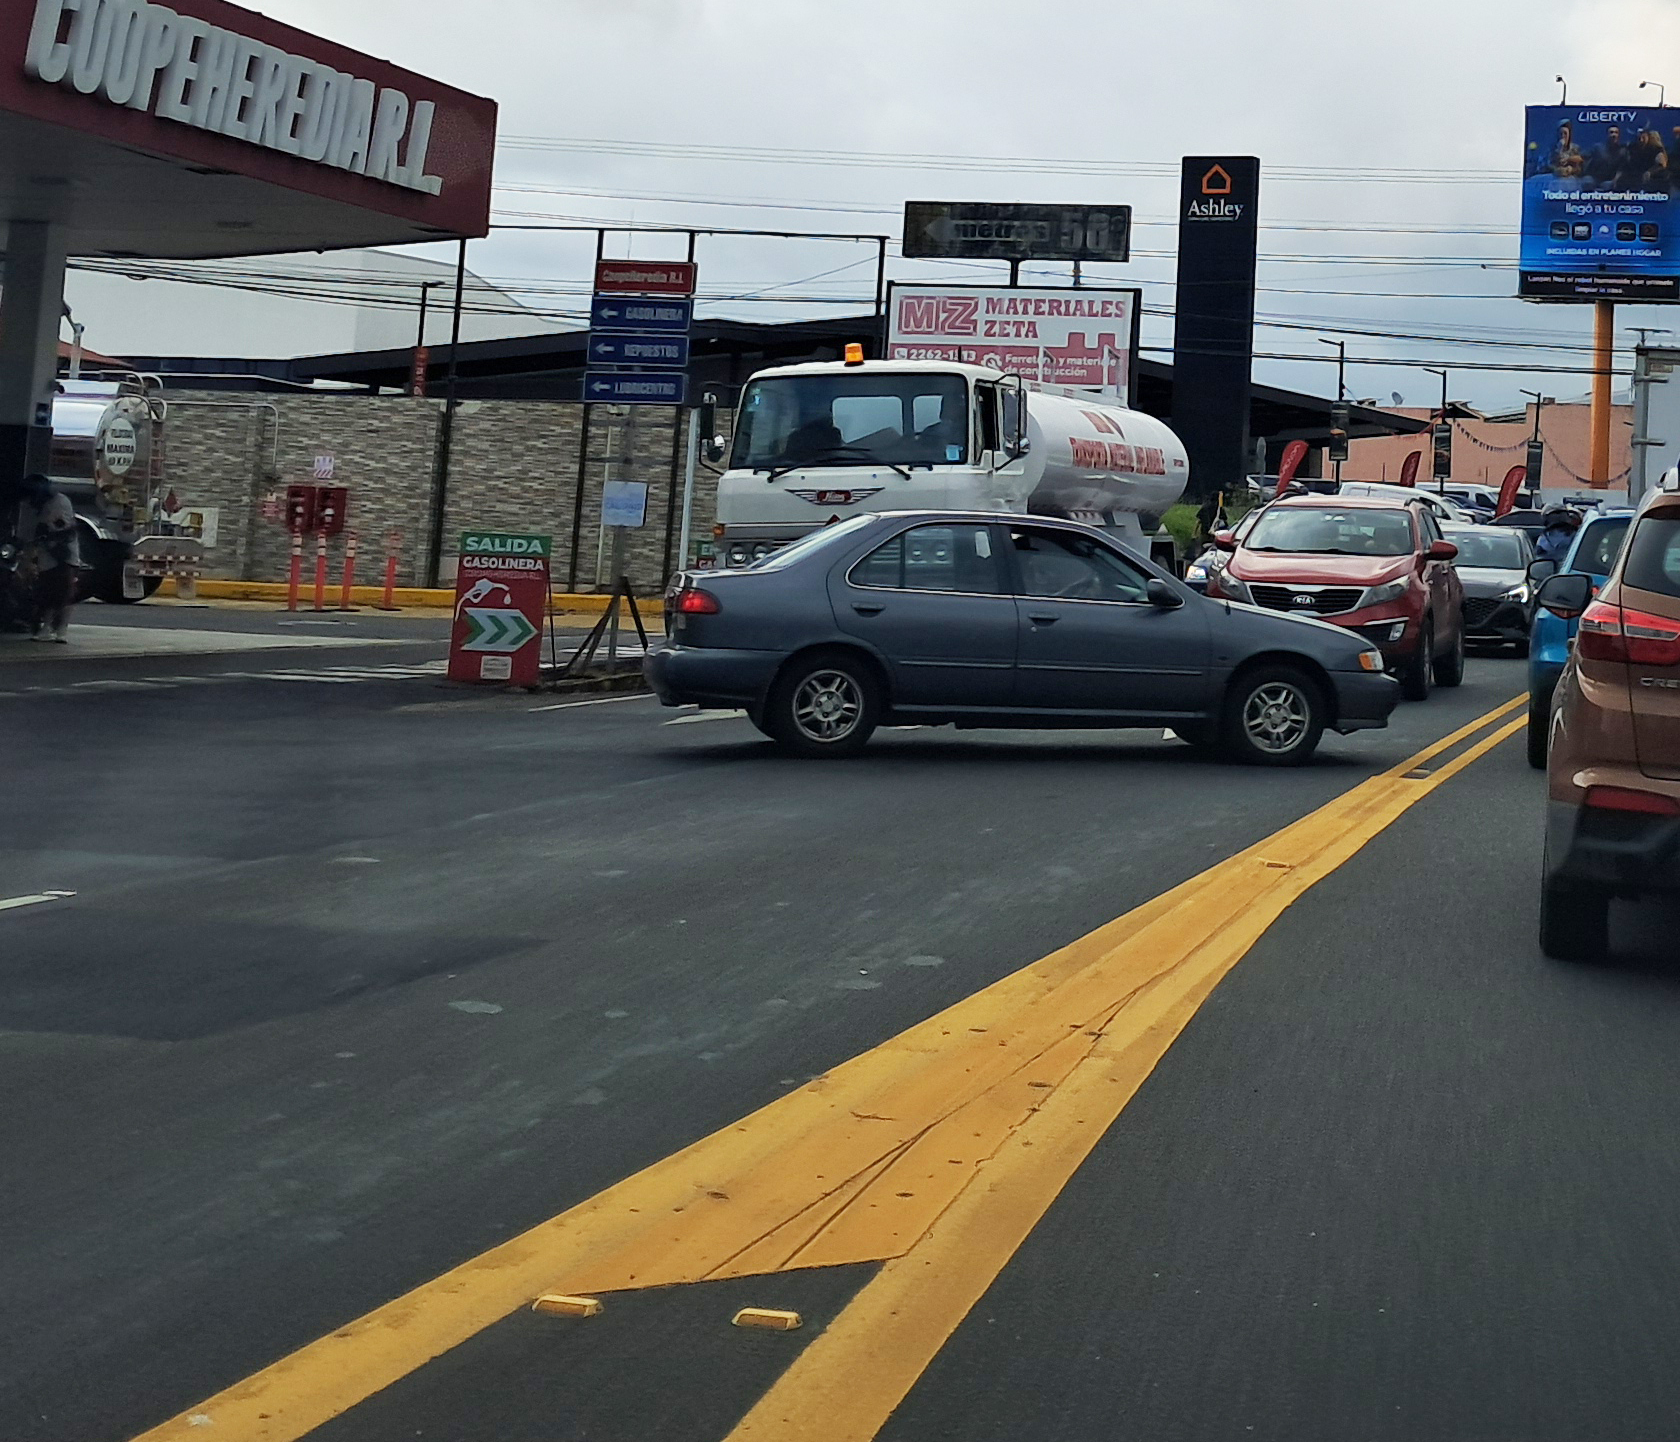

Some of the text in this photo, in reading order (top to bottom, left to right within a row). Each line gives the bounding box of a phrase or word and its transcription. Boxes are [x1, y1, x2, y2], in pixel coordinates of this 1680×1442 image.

[1578, 111, 1637, 123] LIBERTY
[1543, 190, 1669, 202] Todo el entretenimiento
[1187, 198, 1244, 220] Ashley
[1604, 204, 1617, 214] tu
[985, 297, 1126, 318] MATERIALES
[983, 321, 1039, 338] ZETA
[466, 536, 543, 554] SALIDA
[463, 556, 544, 571] GASOLINERA
